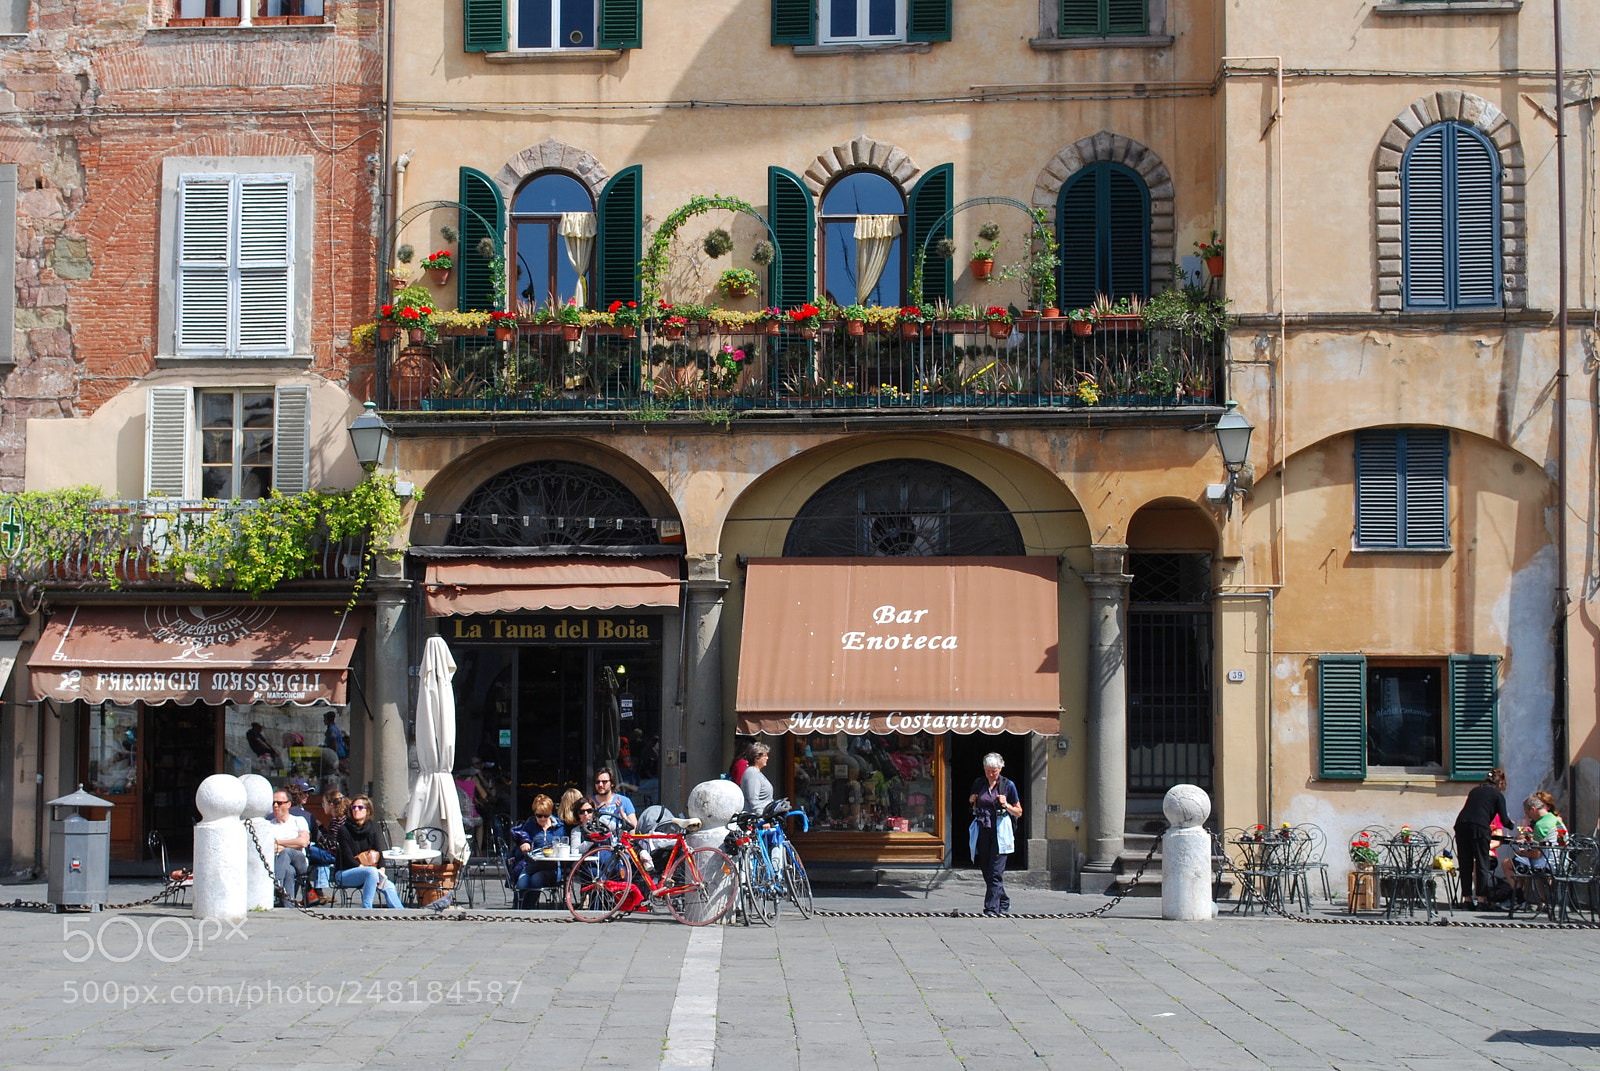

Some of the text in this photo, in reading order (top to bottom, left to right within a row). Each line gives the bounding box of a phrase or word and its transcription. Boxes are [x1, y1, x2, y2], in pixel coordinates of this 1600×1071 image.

[872, 605, 929, 625] Bar
[168, 617, 243, 635] FARMACIA
[453, 618, 649, 639] La Tana del Boia
[153, 627, 251, 647] MASSAGLI
[841, 631, 958, 650] Enoteca
[96, 672, 321, 692] FARMACIA MASSAGLI
[789, 711, 1005, 730] Marsili Costantino
